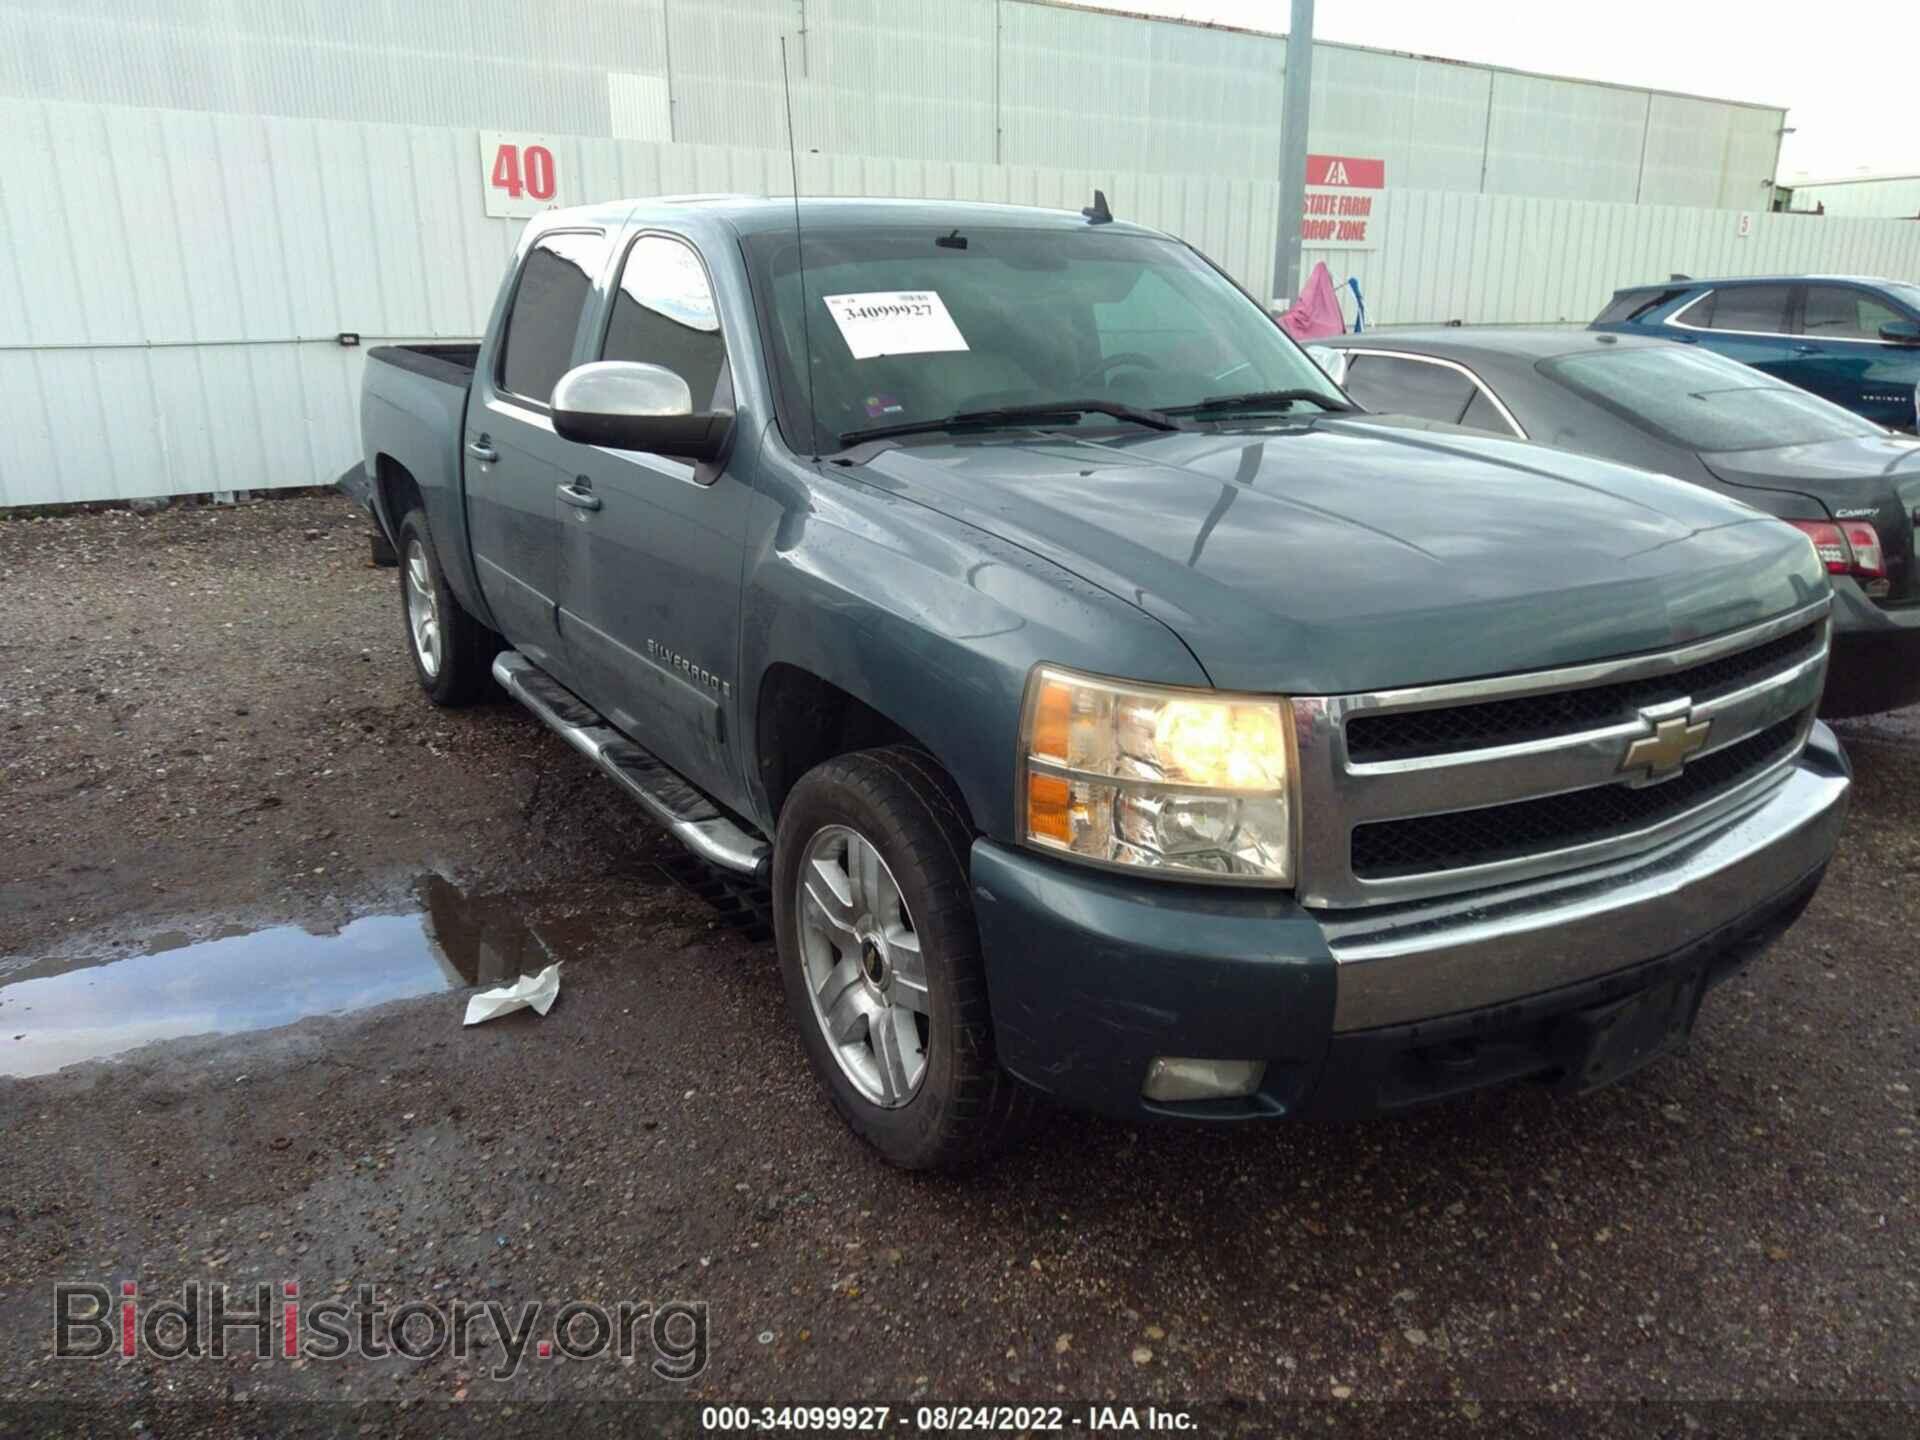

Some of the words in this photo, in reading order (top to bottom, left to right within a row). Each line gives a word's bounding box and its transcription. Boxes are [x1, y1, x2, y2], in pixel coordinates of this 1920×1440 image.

[491, 144, 556, 201] 40
[1302, 194, 1337, 215] STATE
[1339, 196, 1371, 216] FARM
[1302, 220, 1336, 240] DROP
[1337, 221, 1366, 241] ZONE
[844, 304, 933, 320] 34099927
